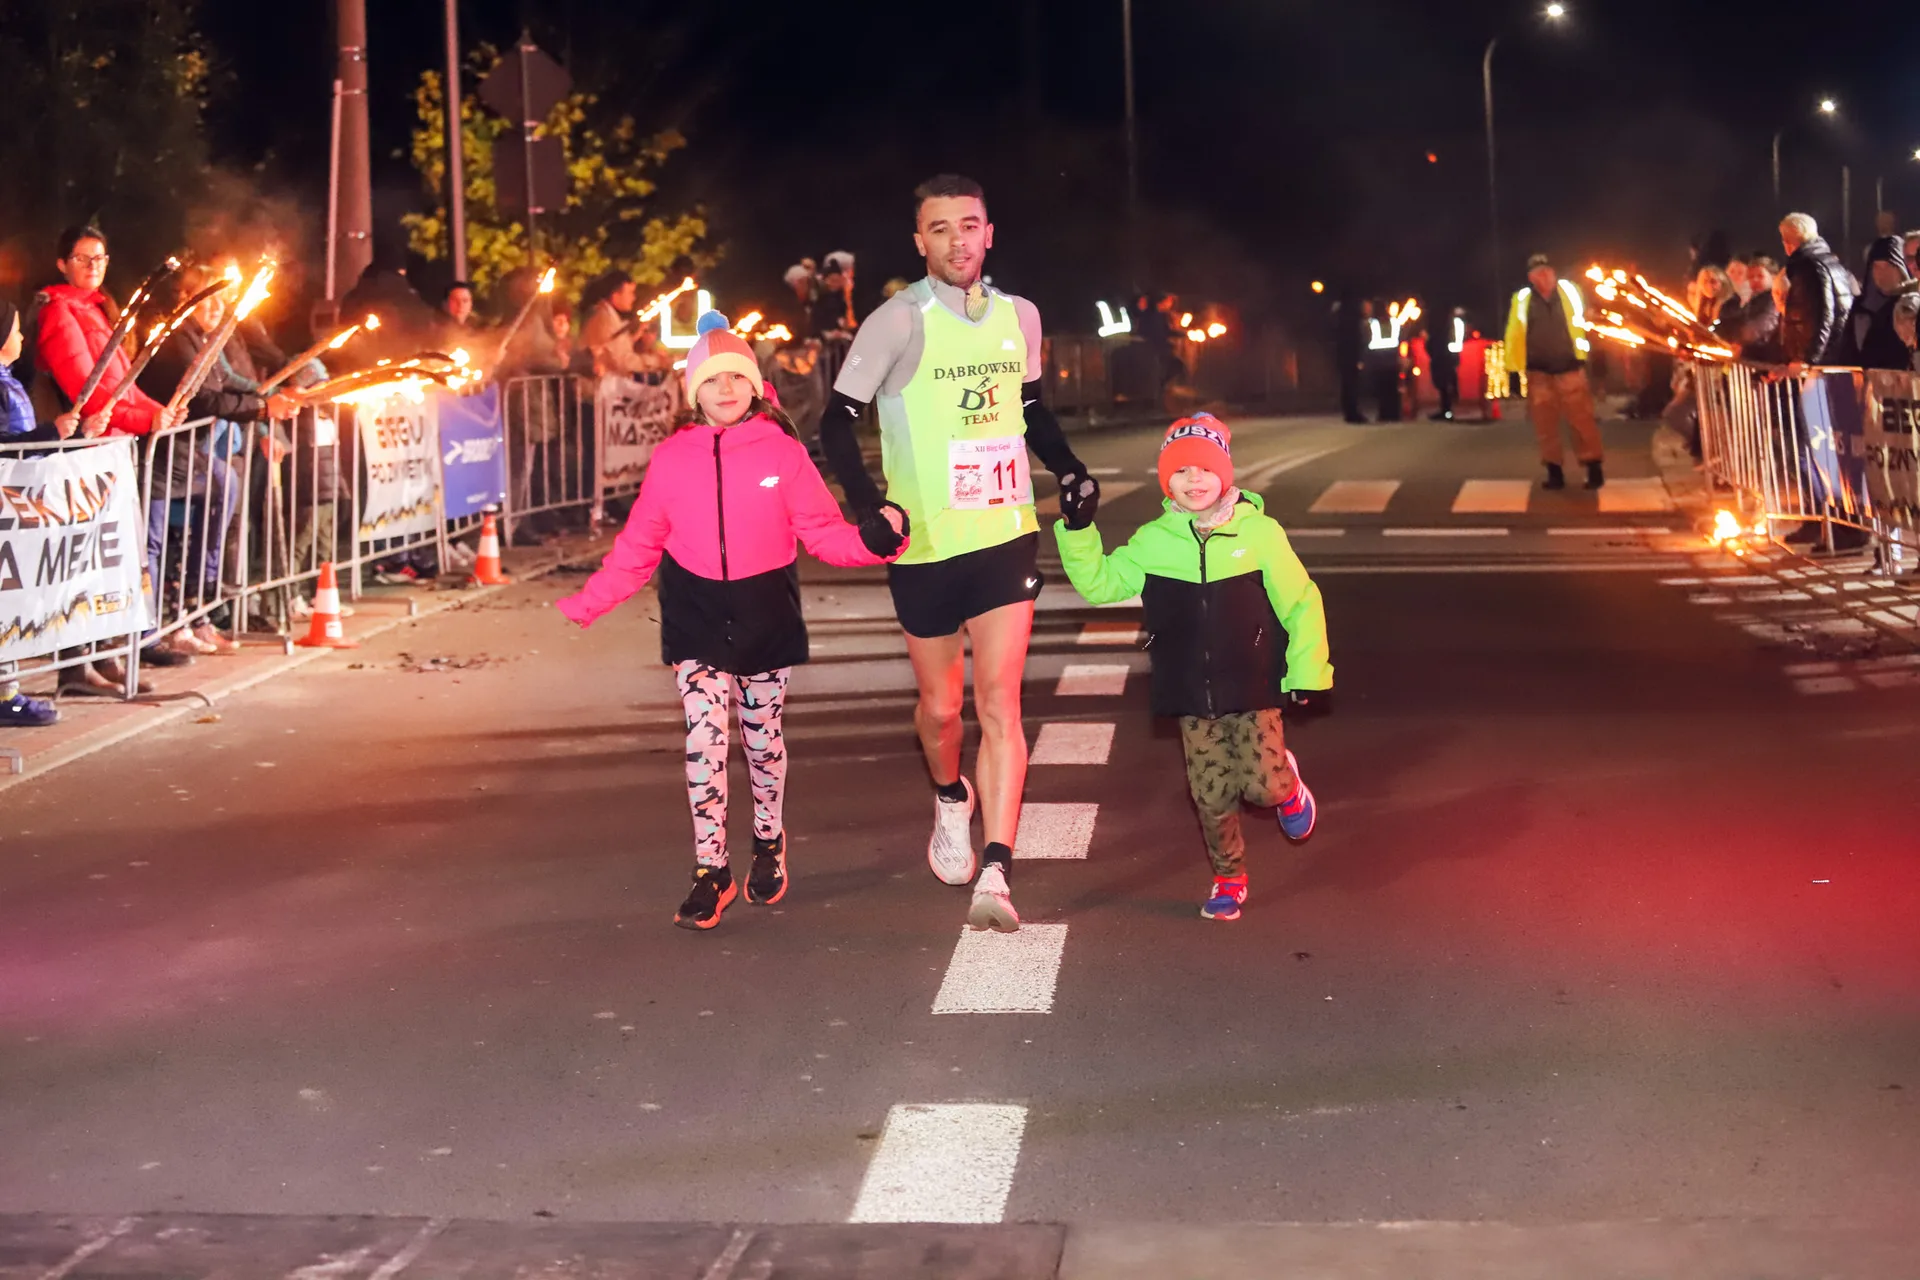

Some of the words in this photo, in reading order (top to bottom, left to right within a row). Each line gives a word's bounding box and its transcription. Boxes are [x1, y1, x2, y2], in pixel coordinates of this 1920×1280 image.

[933, 361, 1021, 381] DĄBROWSKI
[957, 383, 1000, 411] DT
[962, 412, 1000, 426] TEAM
[975, 445, 986, 453] XII
[993, 459, 1017, 491] 11
